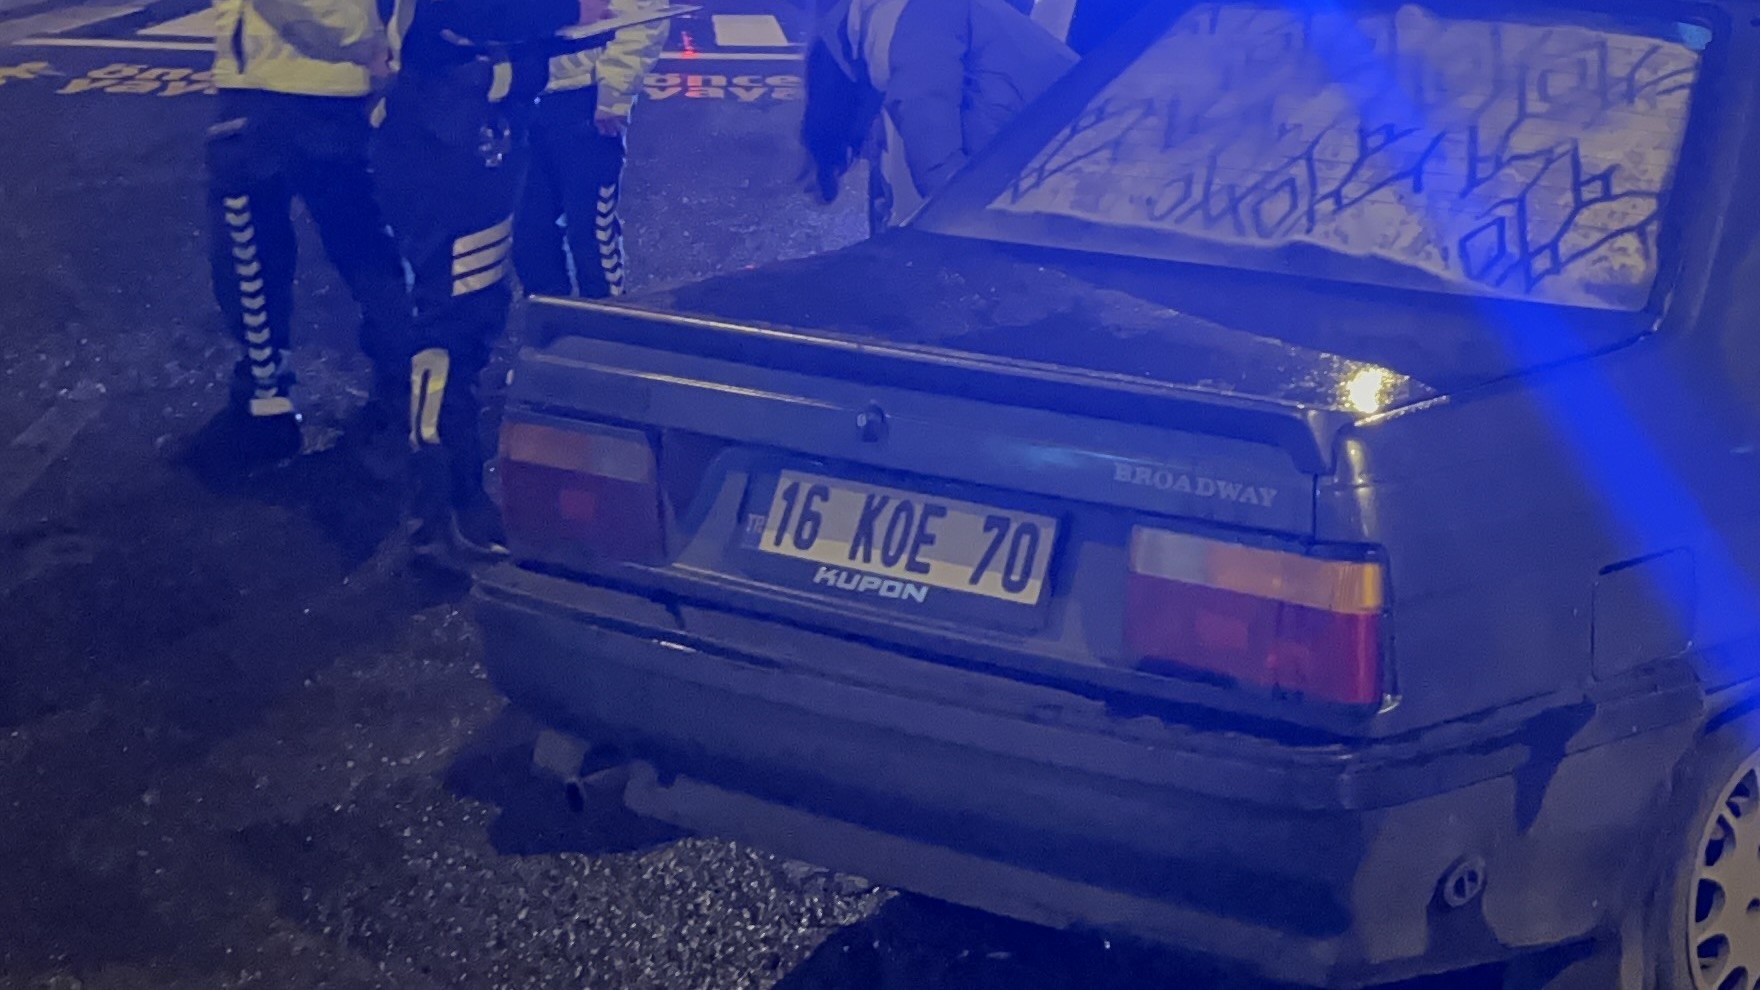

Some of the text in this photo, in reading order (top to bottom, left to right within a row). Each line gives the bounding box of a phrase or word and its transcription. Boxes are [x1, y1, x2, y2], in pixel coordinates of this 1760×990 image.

[1113, 462, 1278, 507] BROADWAY
[774, 482, 1040, 593] 16 KOE 70
[813, 566, 929, 603] KUPON
